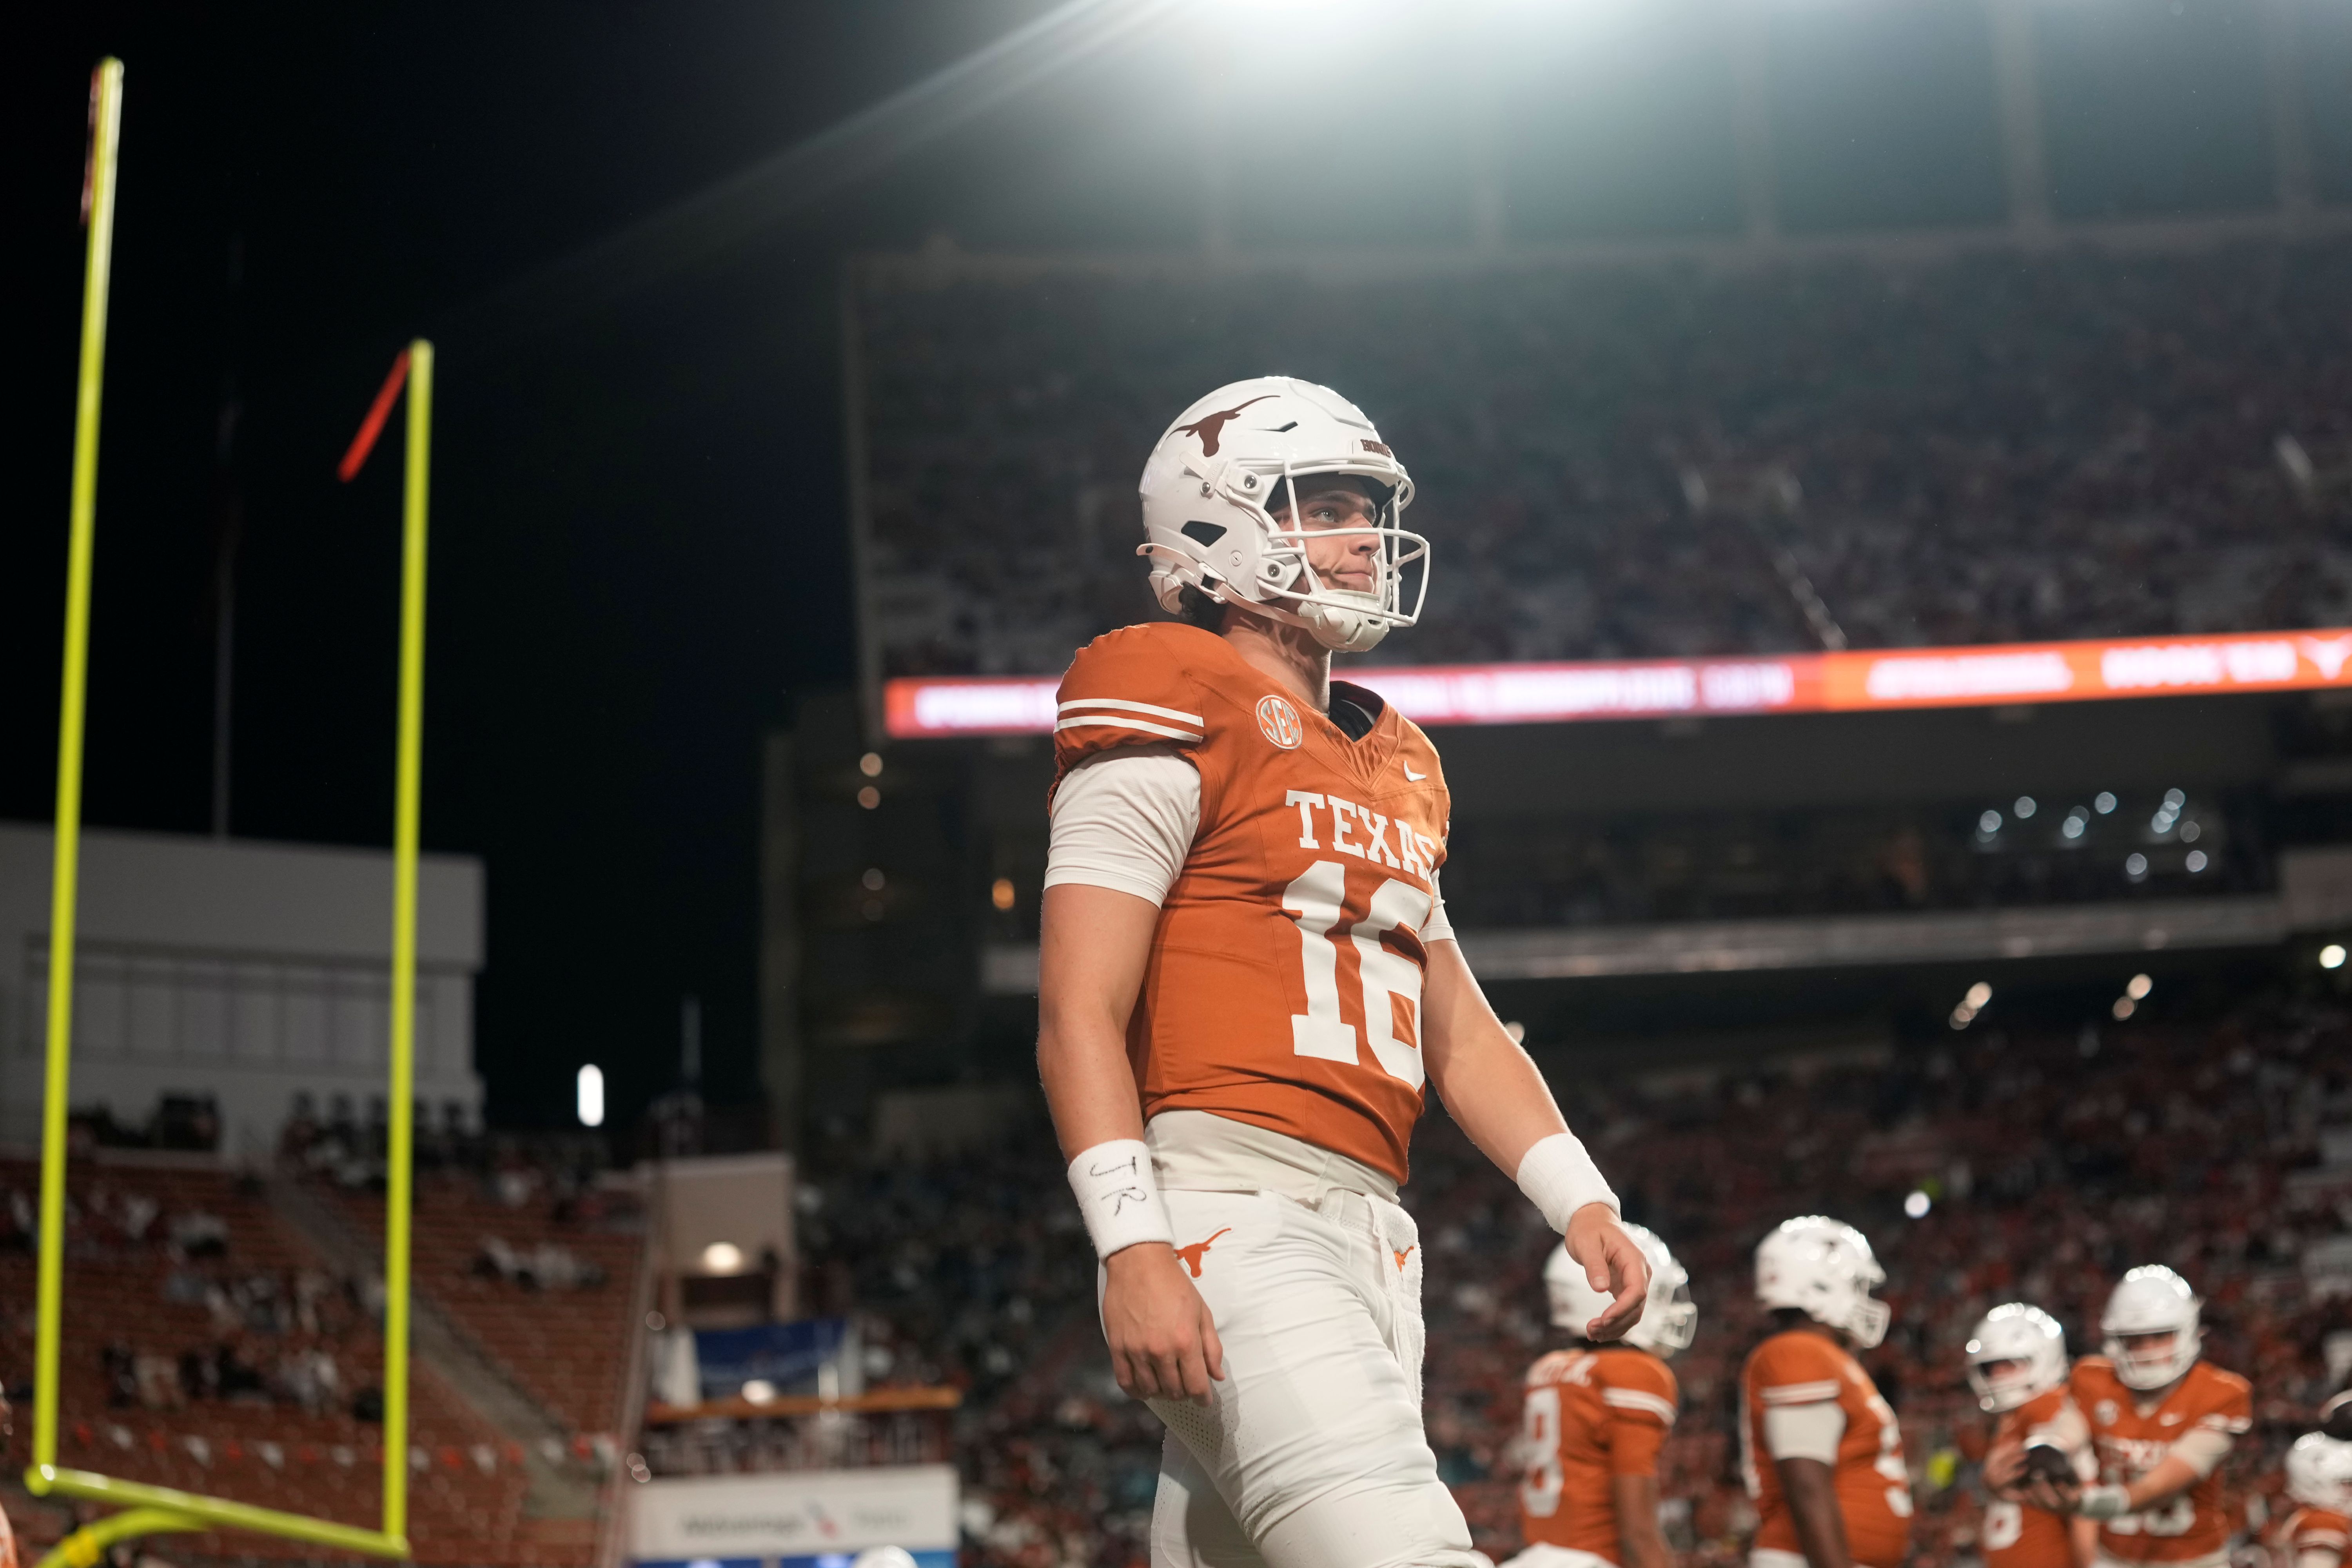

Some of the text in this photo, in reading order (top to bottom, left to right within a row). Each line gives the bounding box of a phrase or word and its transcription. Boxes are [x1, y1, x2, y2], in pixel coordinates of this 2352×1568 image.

[1260, 699, 1299, 744] SEC
[1285, 789, 1434, 891] TEXAS
[1282, 860, 1432, 1093] 16
